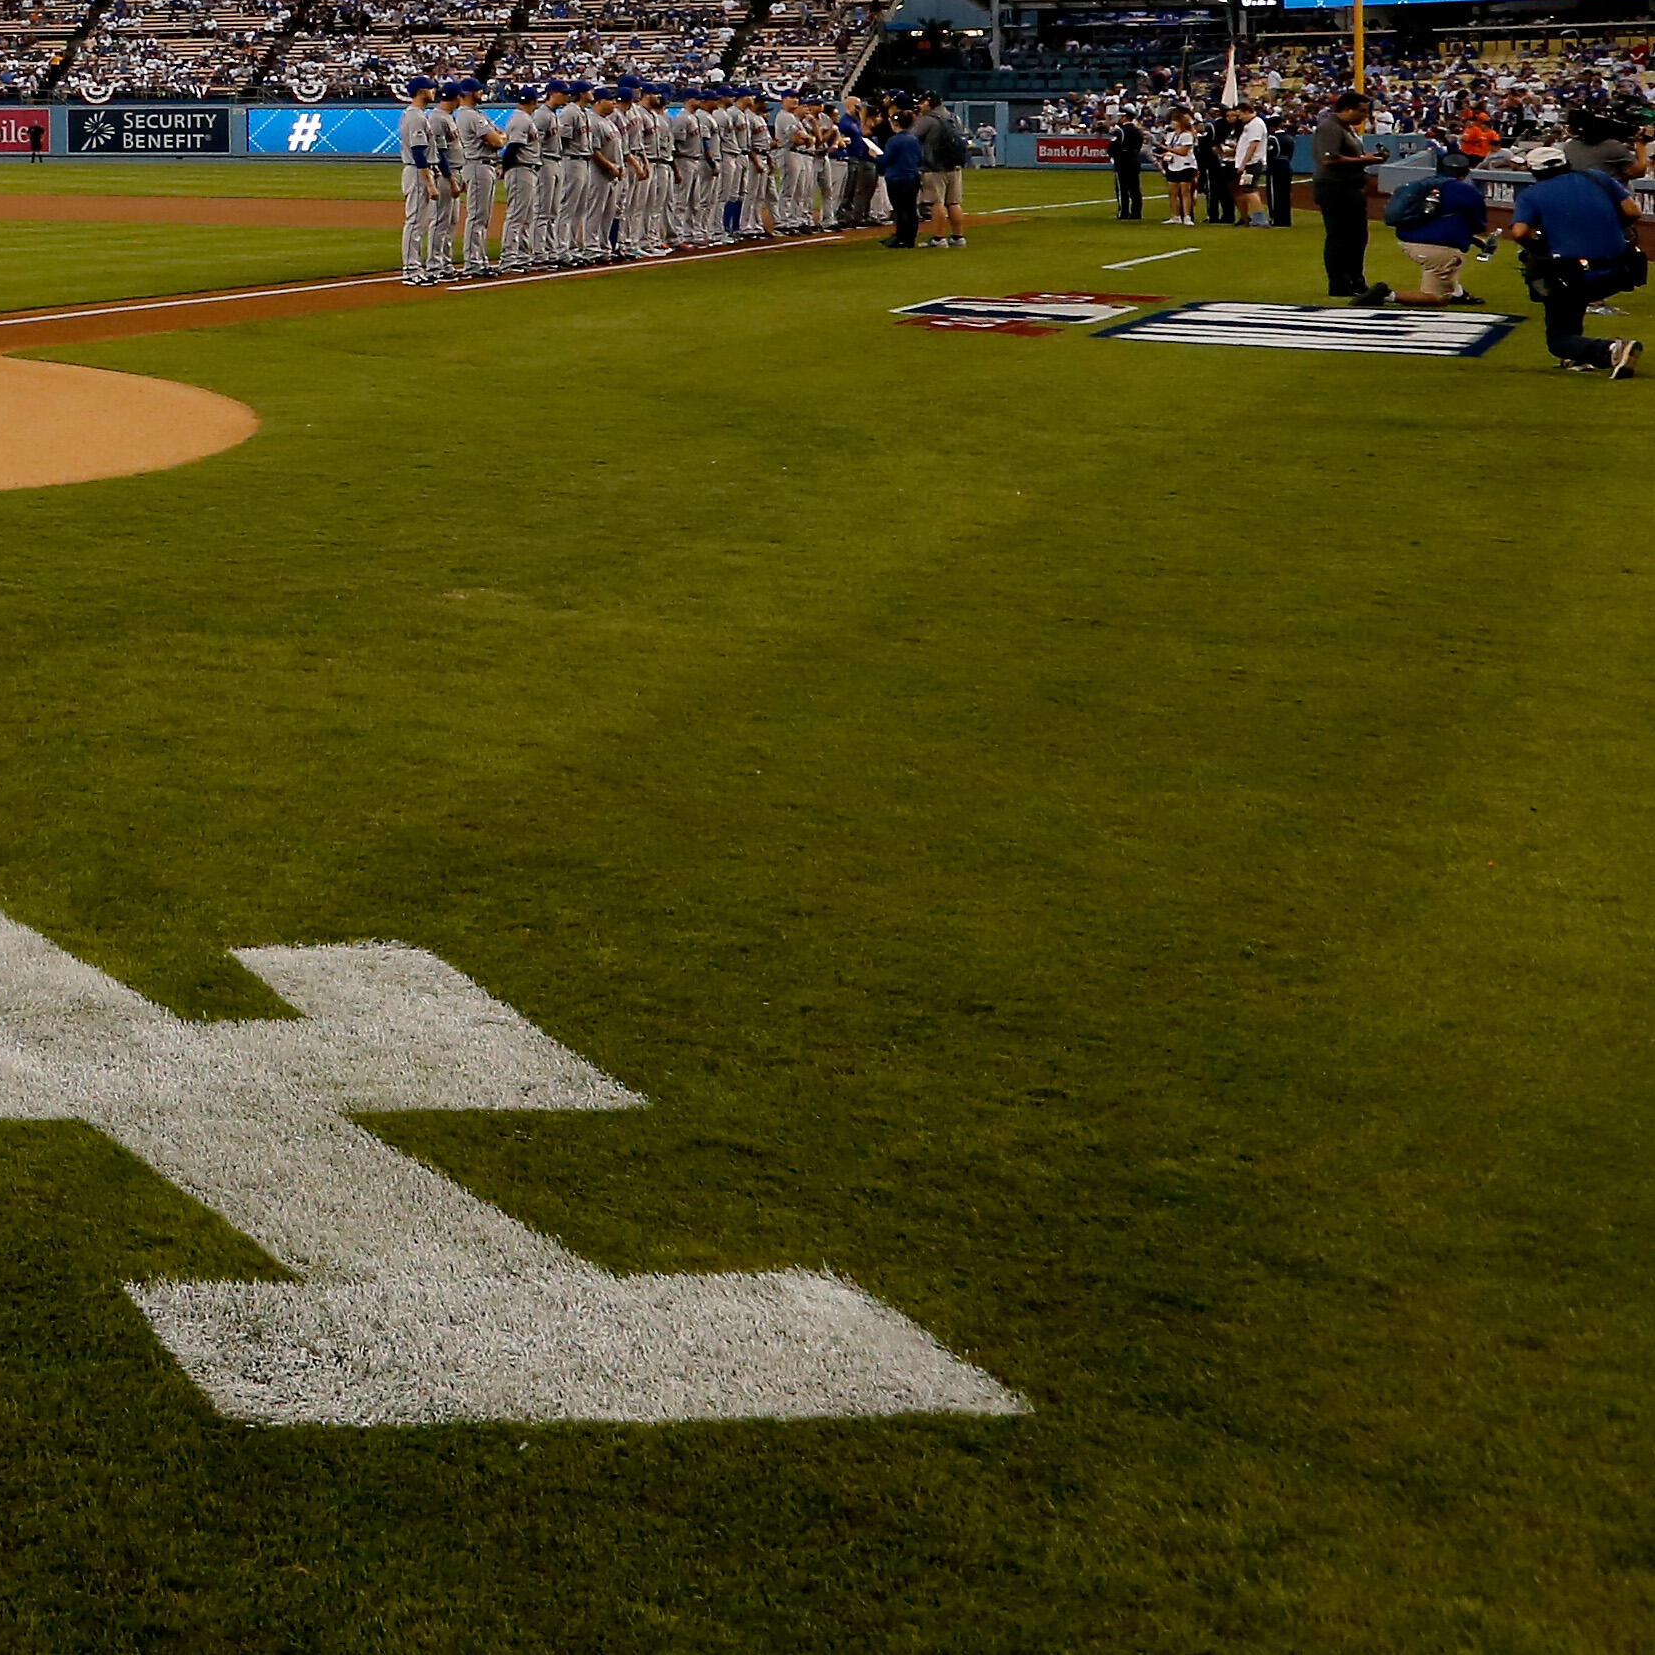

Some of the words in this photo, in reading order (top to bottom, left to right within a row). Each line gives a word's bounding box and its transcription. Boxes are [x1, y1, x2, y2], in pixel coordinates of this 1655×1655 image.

[123, 112, 218, 129] SECURITY
[123, 133, 205, 149] BENEFIT
[1038, 145, 1068, 158] Bank
[1068, 146, 1081, 158] of
